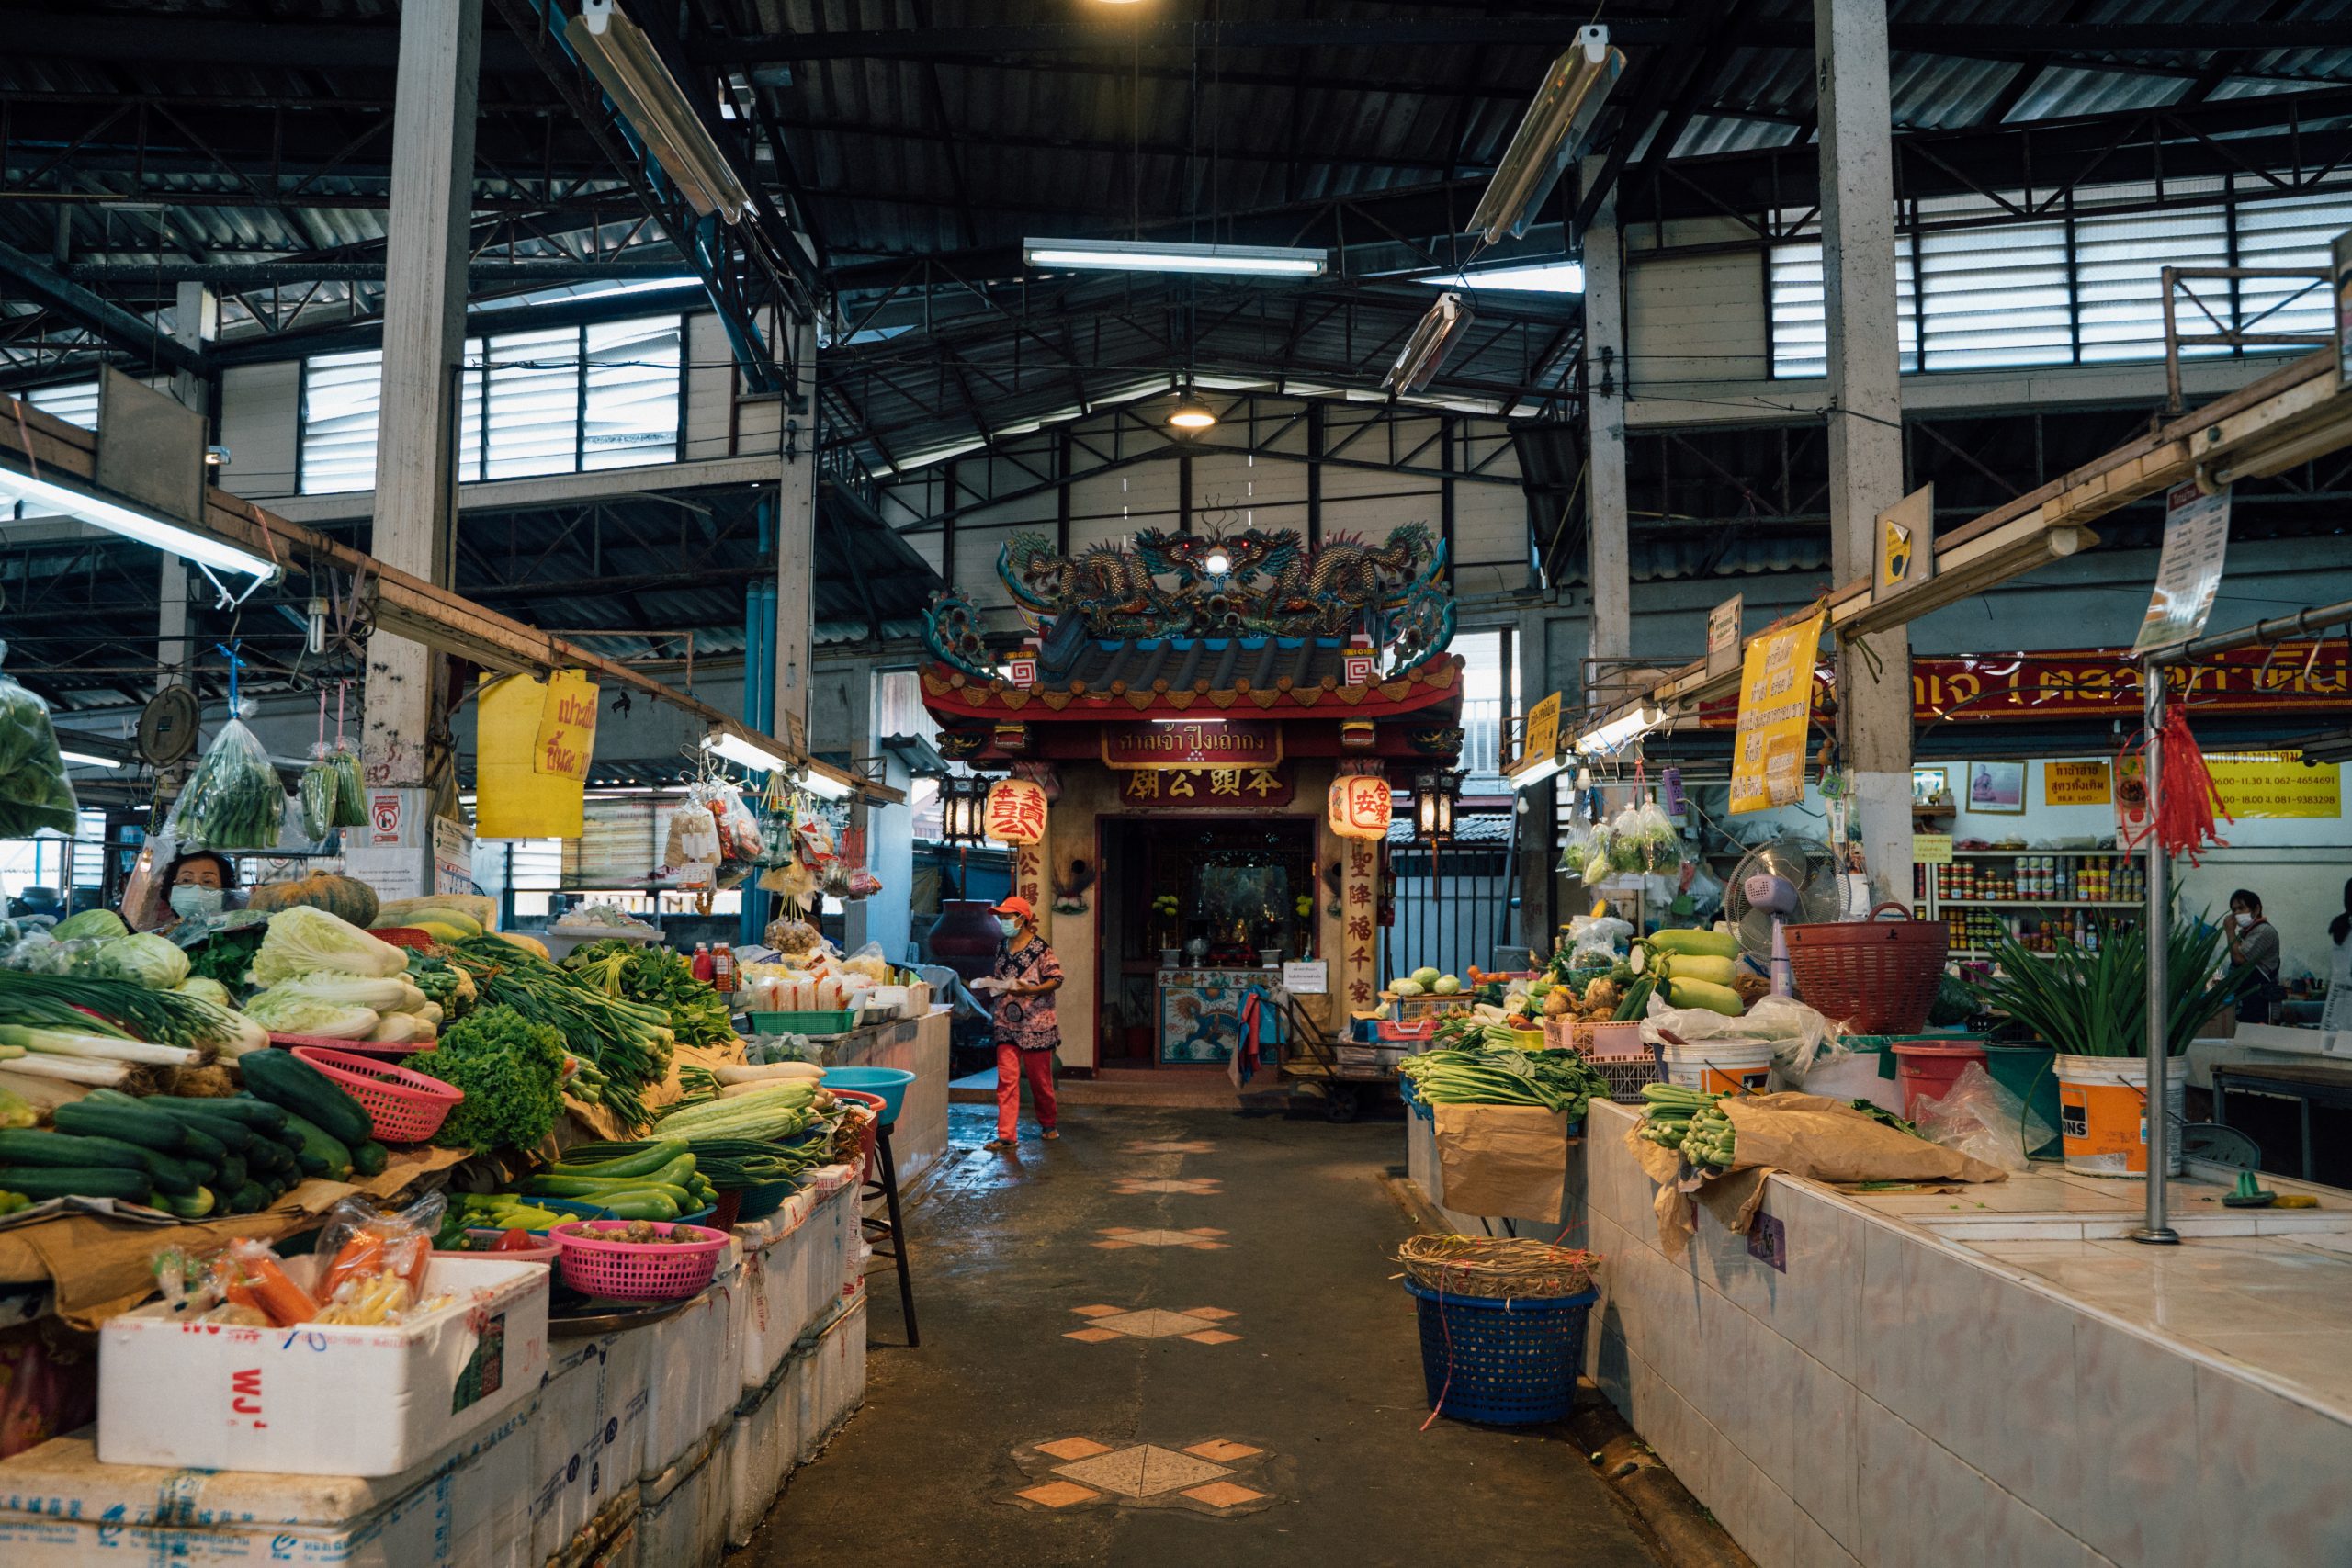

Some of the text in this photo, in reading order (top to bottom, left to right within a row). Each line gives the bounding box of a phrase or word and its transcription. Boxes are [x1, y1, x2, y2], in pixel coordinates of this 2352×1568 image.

[1119, 723, 1182, 750] ศาลเจ้า
[2274, 776, 2335, 785] 062-4654691
[2212, 795, 2264, 804] 1.00-18.00
[2275, 795, 2335, 804] 081-9383298
